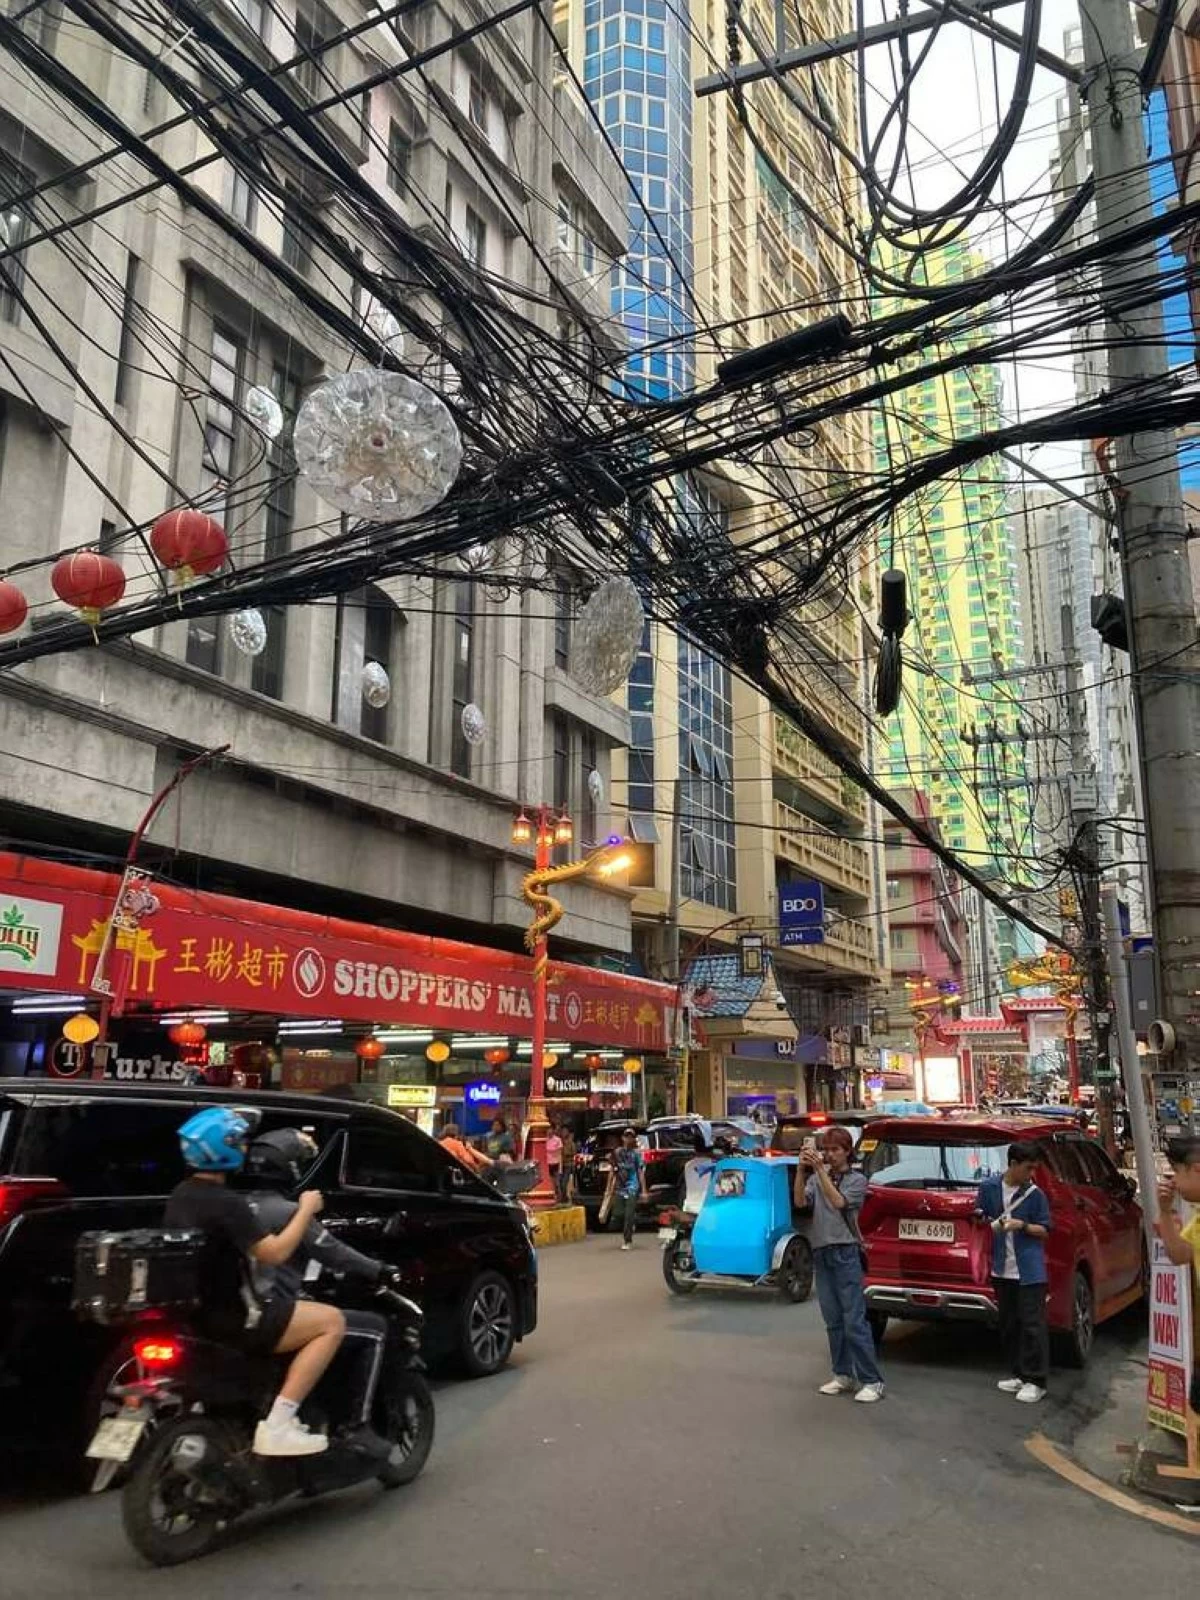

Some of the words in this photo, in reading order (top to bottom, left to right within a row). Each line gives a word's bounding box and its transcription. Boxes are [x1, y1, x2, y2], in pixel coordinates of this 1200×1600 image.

[782, 898, 817, 912] BDO
[784, 932, 803, 942] ATM
[173, 936, 289, 990] 王彬超市
[334, 958, 492, 1011] SHOPPERS'
[496, 984, 560, 1022] MAT
[926, 1224, 953, 1238] 6690
[1156, 1272, 1177, 1306] ONE
[1153, 1310, 1179, 1350] WAY
